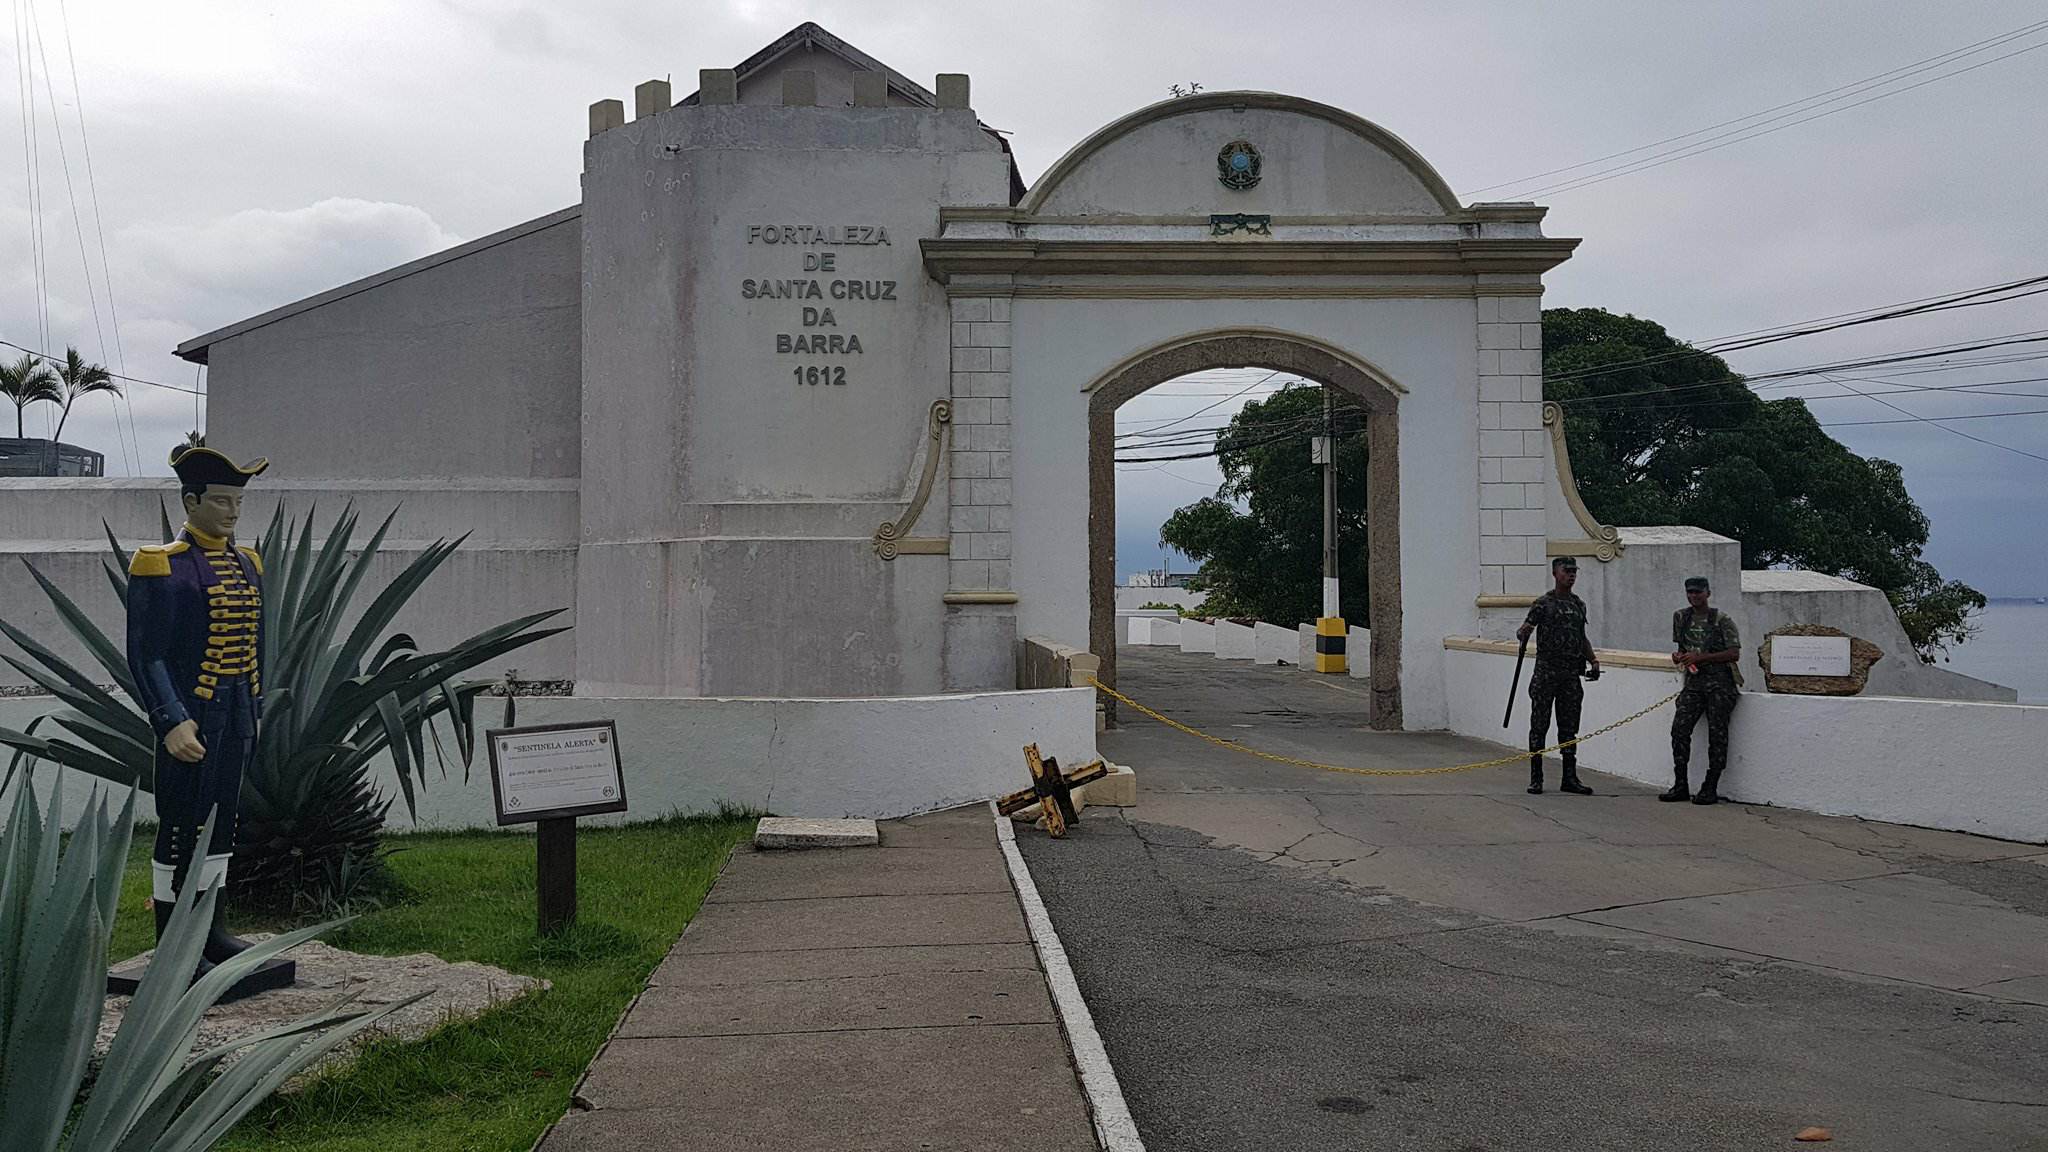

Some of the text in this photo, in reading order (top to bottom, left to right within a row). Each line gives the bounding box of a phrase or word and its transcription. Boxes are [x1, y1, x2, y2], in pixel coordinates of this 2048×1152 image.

[747, 224, 892, 246] FORTALEZA
[803, 252, 836, 272] DE
[741, 279, 897, 300] SANTA CRUZ
[802, 307, 837, 326] DA
[776, 334, 864, 354] BARRA
[793, 366, 847, 385] 1612
